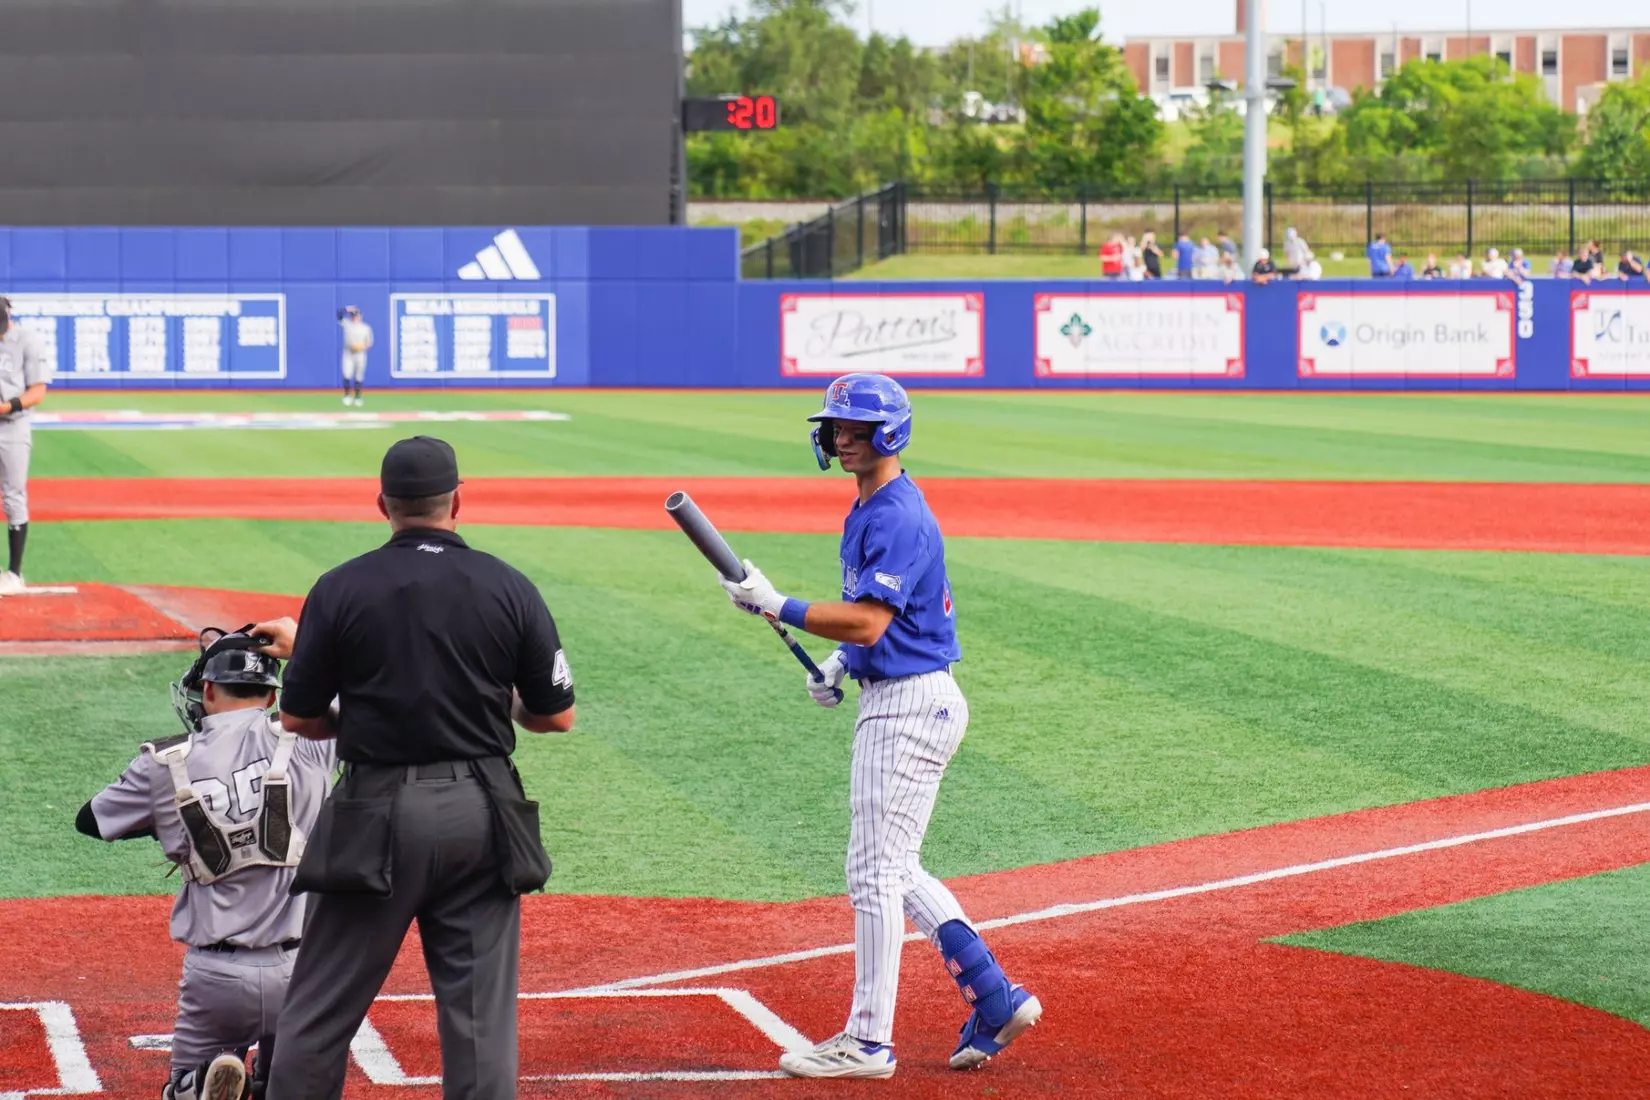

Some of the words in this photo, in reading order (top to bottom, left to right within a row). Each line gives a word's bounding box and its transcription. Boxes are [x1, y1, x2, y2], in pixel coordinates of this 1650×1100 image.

[1355, 323, 1425, 347] Origin
[1434, 323, 1489, 343] Bank
[551, 649, 573, 690] 4
